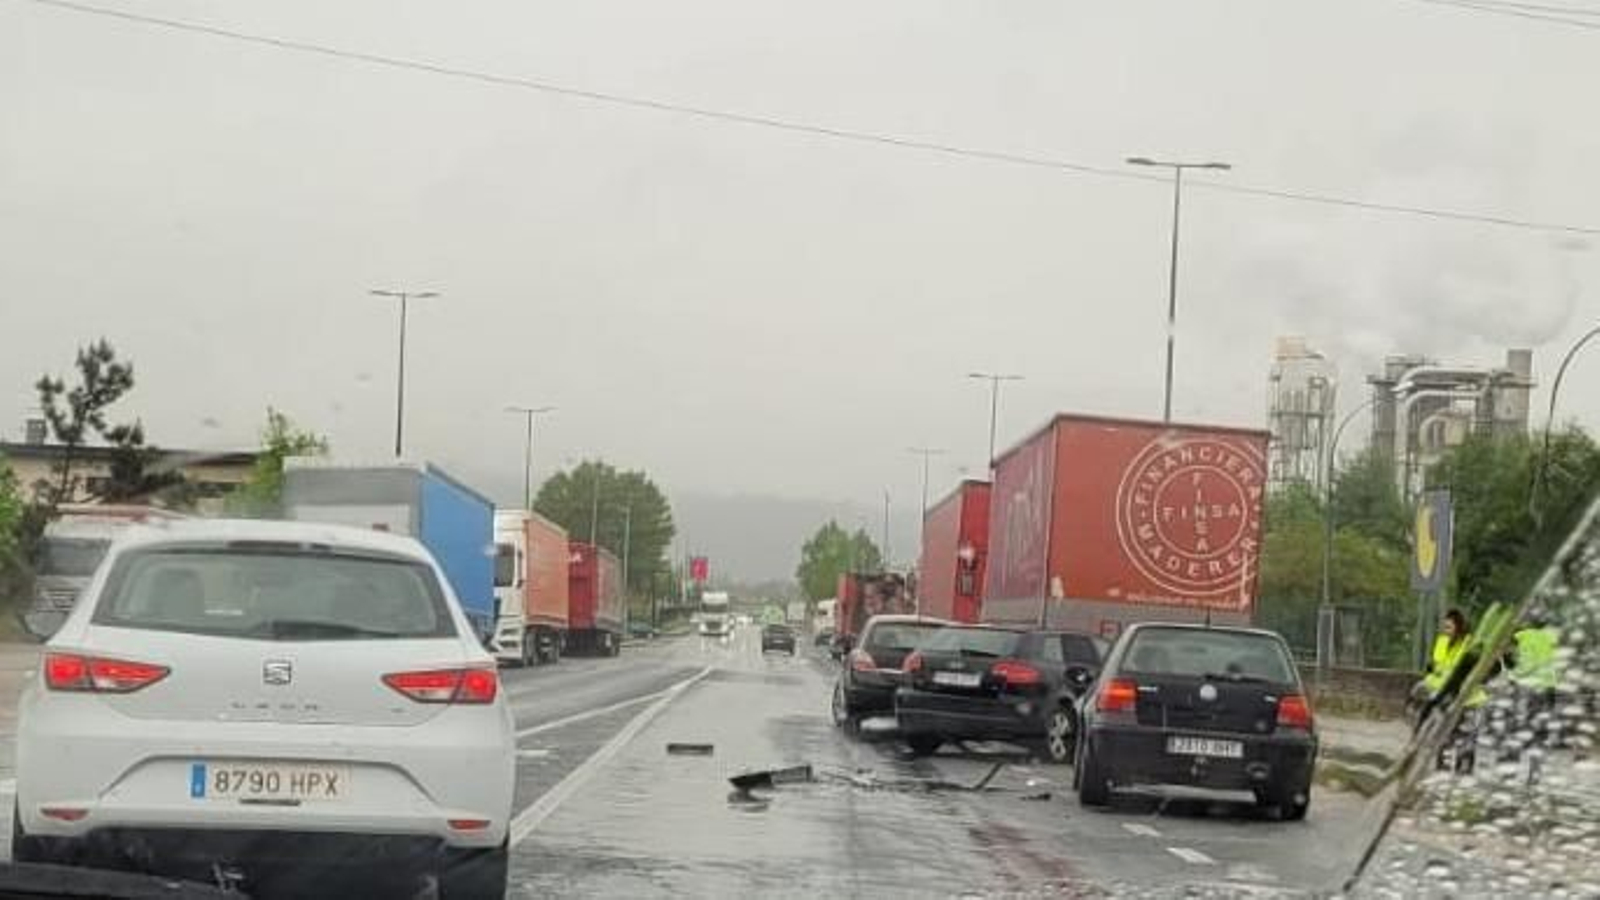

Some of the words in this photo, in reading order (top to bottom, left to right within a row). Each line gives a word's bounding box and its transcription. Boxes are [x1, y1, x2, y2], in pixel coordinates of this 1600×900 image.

[1163, 503, 1240, 521] FINSA
[215, 770, 280, 793] 8790
[290, 772, 338, 796] HPX
